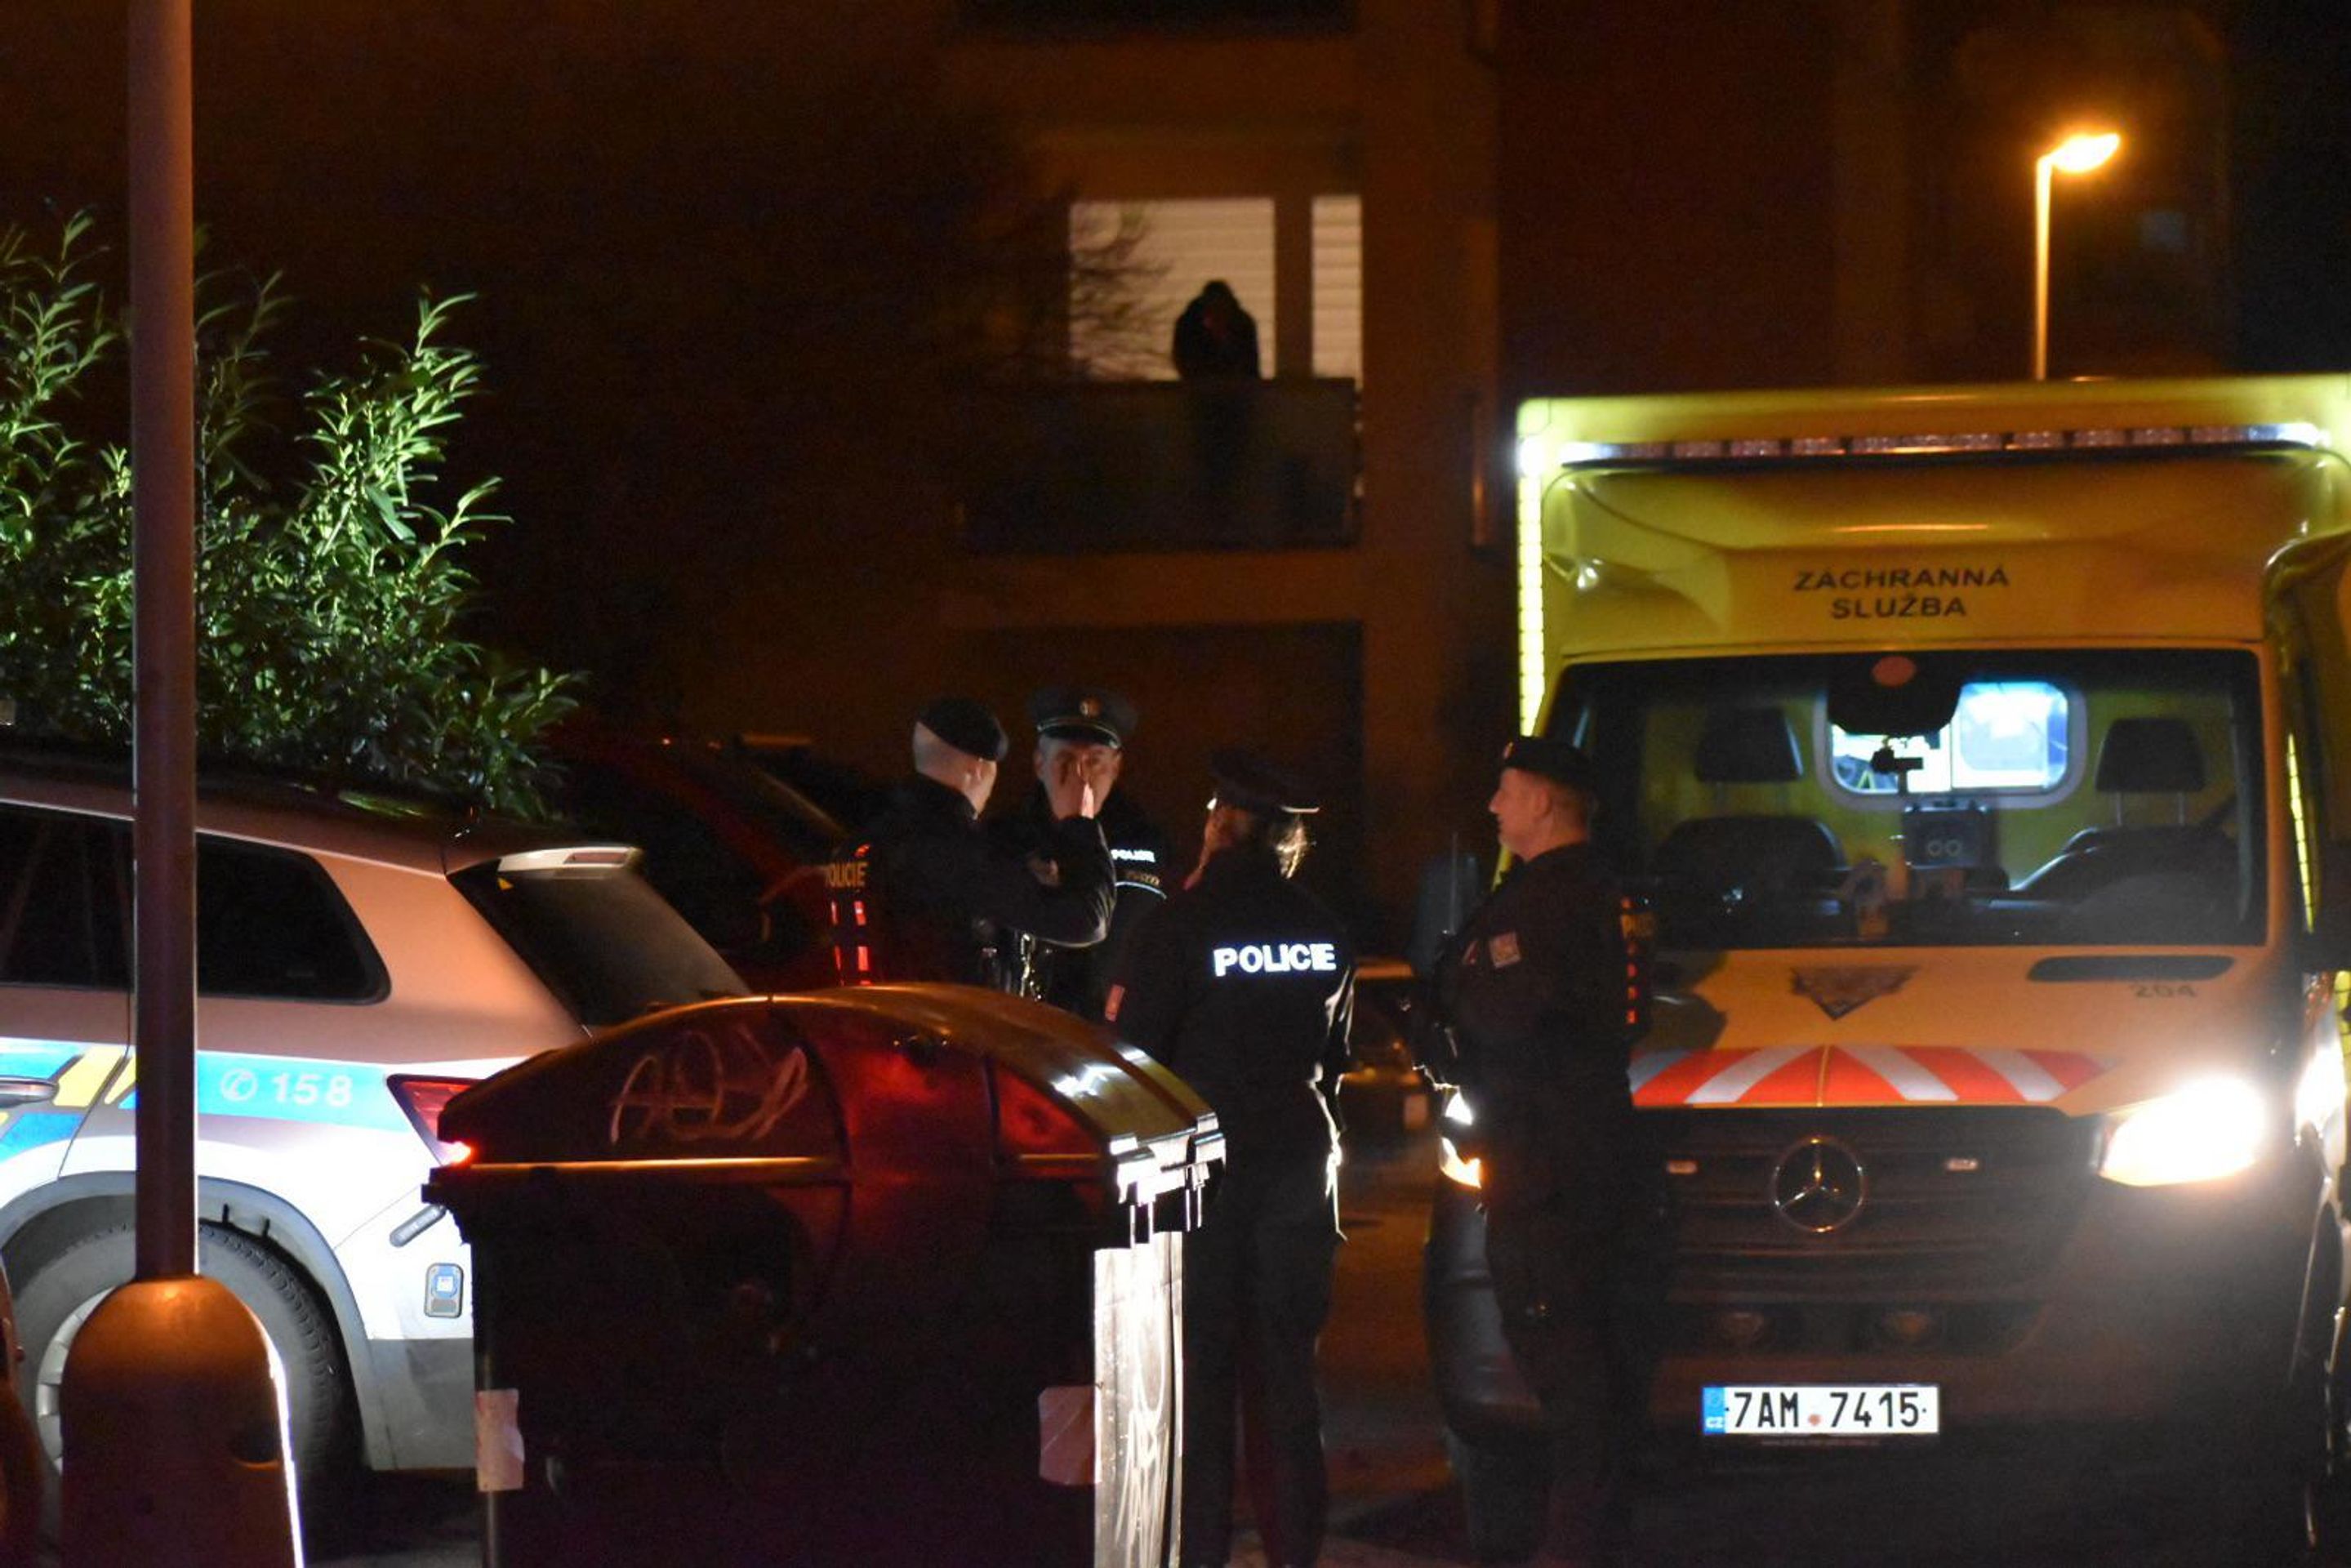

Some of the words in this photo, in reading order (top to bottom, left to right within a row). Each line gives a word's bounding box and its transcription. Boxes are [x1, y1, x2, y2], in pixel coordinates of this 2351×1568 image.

[1832, 594, 1966, 620] SLUŽBA
[1213, 942, 1337, 977] POLICIE
[273, 1073, 354, 1107] 158
[1734, 1392, 1799, 1428] 7AM
[1830, 1392, 1918, 1428] 7415
